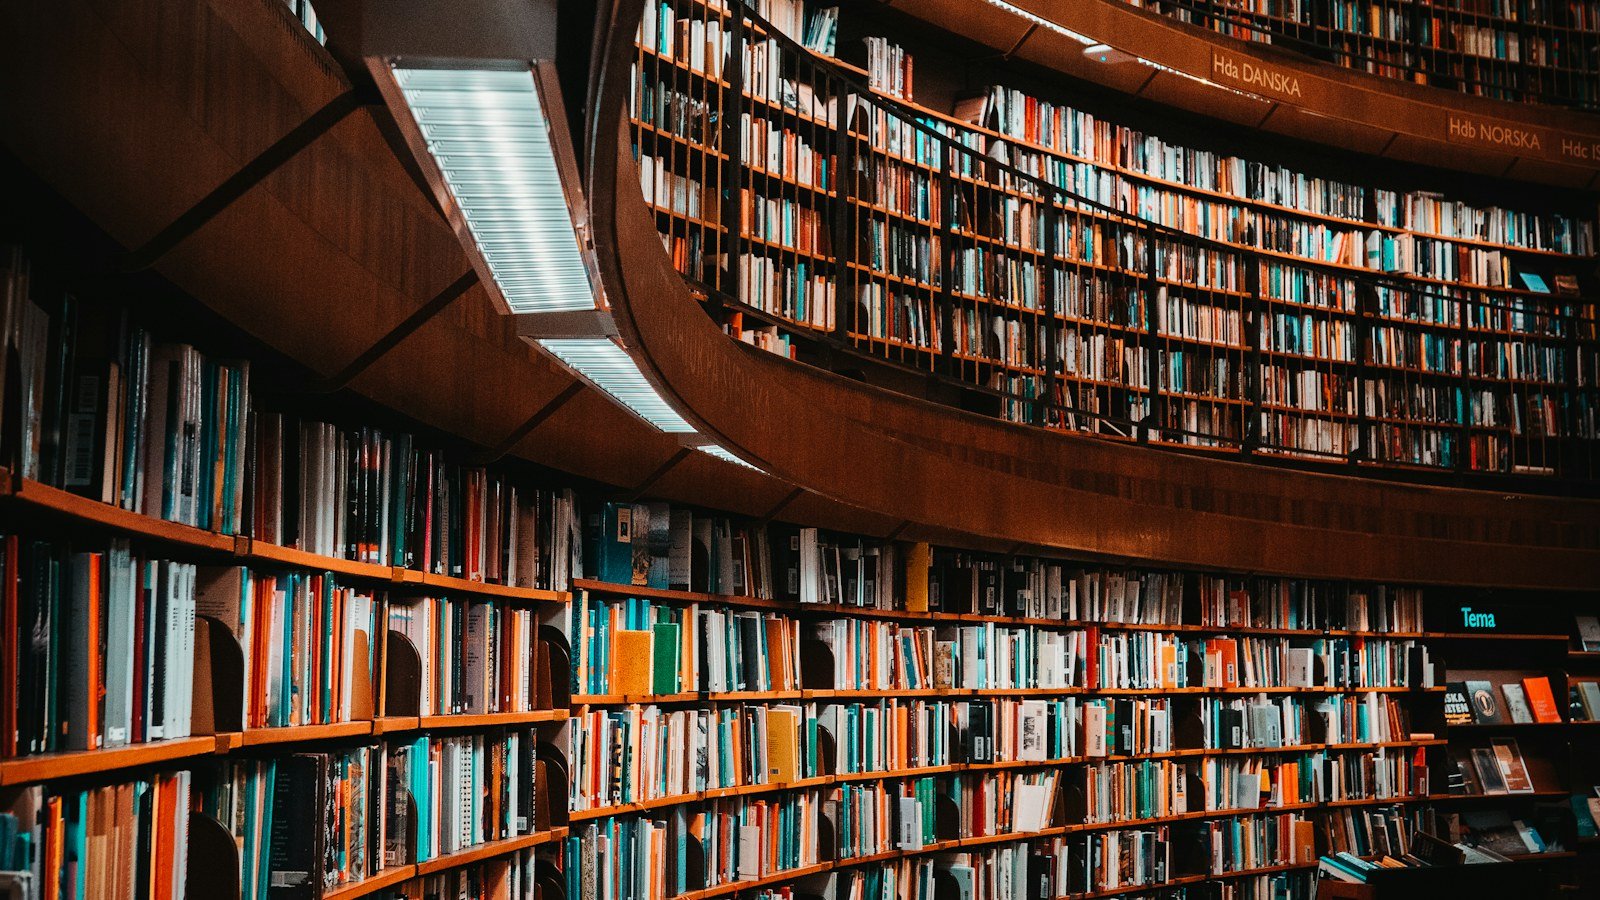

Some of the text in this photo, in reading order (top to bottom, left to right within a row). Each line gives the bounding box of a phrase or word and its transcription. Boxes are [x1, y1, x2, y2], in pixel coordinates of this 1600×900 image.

[1214, 54, 1301, 97] Hda DANSKA
[1449, 118, 1541, 150] Hdb NORSKA
[1562, 138, 1588, 159] Hdc
[1461, 607, 1496, 627] Tema
